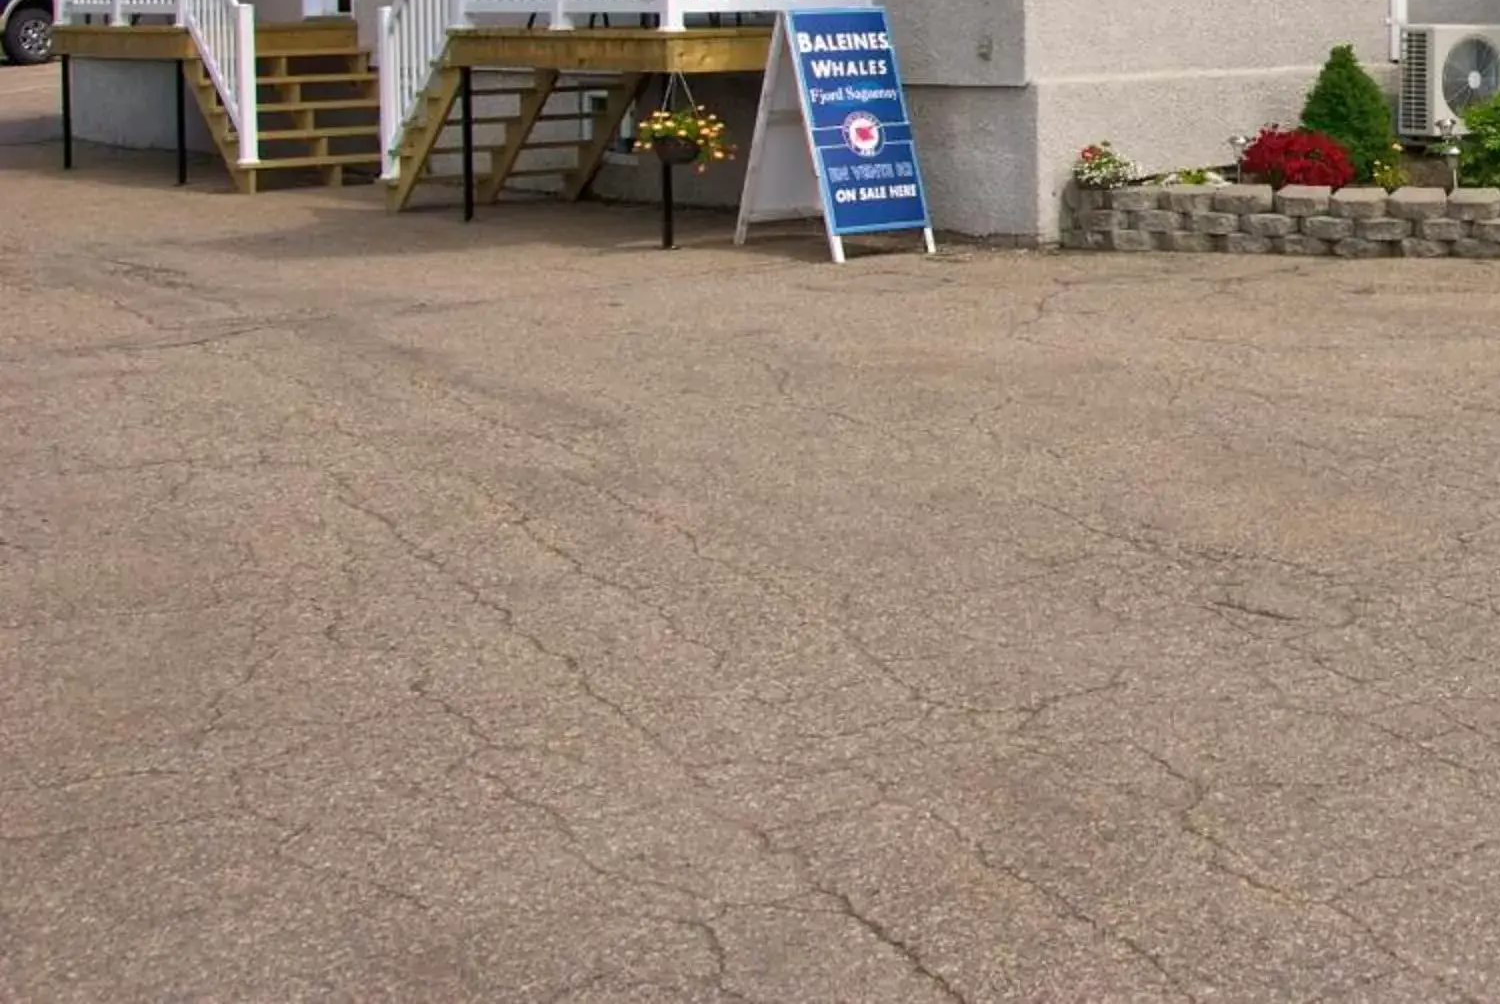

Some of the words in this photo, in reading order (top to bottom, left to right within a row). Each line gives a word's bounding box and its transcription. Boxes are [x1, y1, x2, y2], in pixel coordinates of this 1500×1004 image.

[797, 31, 889, 53] BALEINES
[811, 59, 888, 78] WHALES
[835, 188, 857, 204] ON
[859, 185, 887, 201] SALE
[889, 183, 917, 198] HERE
